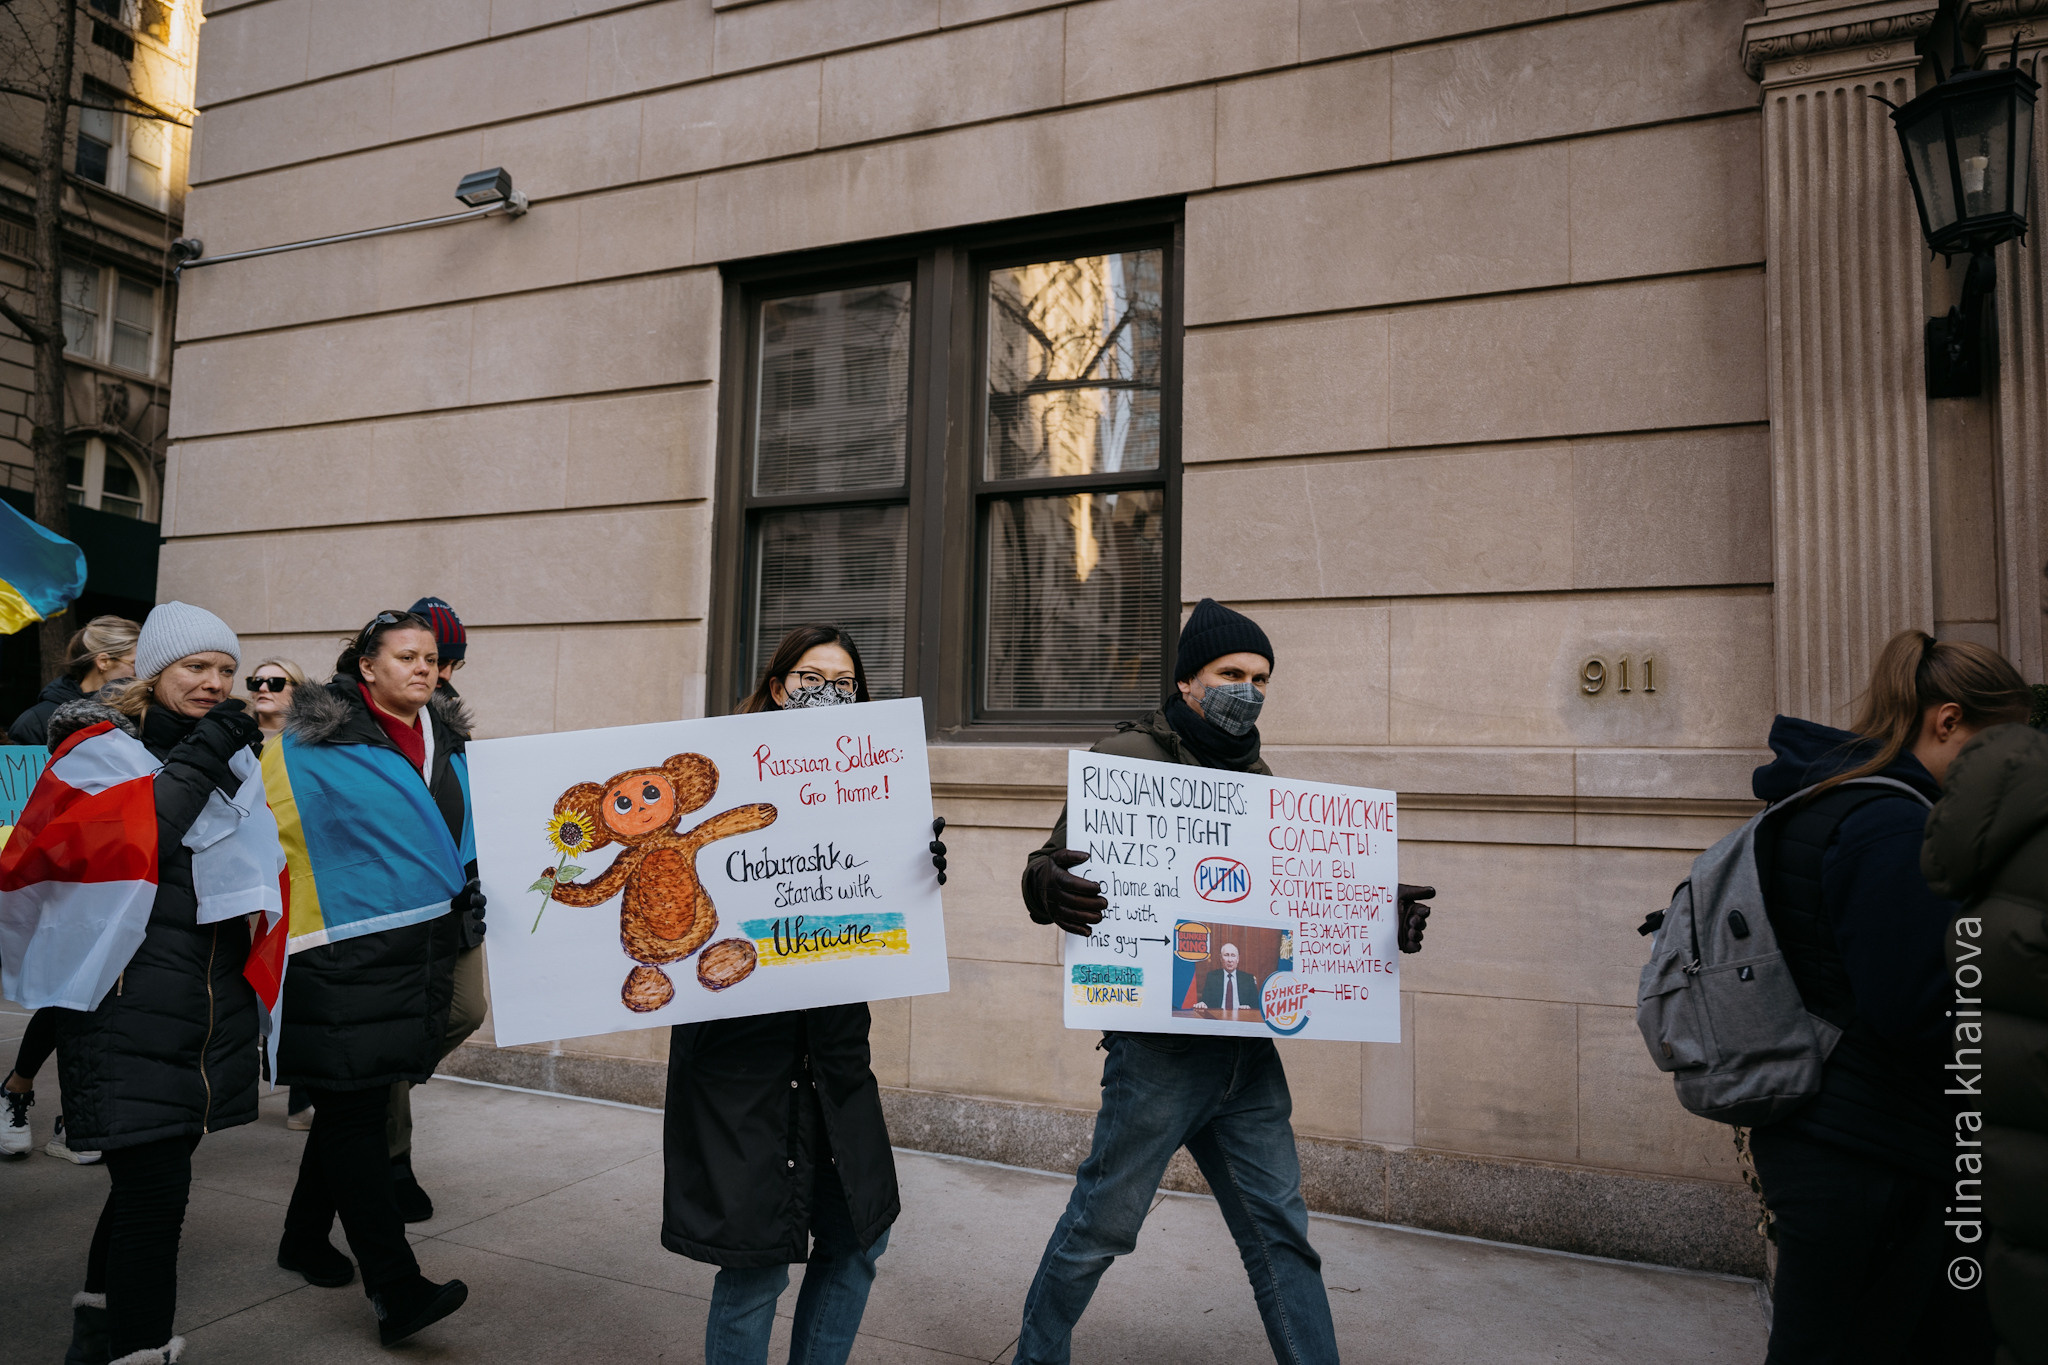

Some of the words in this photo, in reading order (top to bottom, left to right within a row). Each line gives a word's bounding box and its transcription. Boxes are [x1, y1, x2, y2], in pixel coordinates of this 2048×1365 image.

[1583, 657, 1656, 693] 911
[753, 744, 831, 782] Russian
[836, 734, 904, 773] Soldiers:
[800, 782, 827, 806] Go
[835, 775, 890, 805] home!
[1083, 766, 1165, 808] RUSSIAN
[1170, 777, 1247, 816] SOLDIERS:
[1270, 788, 1394, 832] РОССИЙСКИЕ
[1084, 808, 1137, 837] WANT
[1147, 814, 1168, 840] TO
[1177, 816, 1231, 847] FIGHT
[726, 841, 869, 883] Cheburashka
[1272, 856, 1323, 878] ЕСЛИ
[1332, 859, 1355, 879] ВЫ
[774, 875, 833, 908] Stands
[838, 874, 882, 900] with
[1112, 871, 1150, 897] home
[1153, 876, 1181, 898] and
[1200, 865, 1246, 892] PUTIN
[1269, 879, 1333, 901] ХОТИТЕ
[1337, 882, 1394, 904] ВОЕВАТЬ
[1126, 905, 1158, 923] with
[1270, 900, 1280, 916] С
[771, 915, 886, 957] Ukraine
[1178, 931, 1207, 941] BUNKER
[1300, 921, 1369, 940] ЕЗЖАЙТЕ
[1114, 935, 1138, 958] guy
[1178, 941, 1207, 953] KING
[1299, 940, 1351, 957] ДОМОЙ
[1362, 942, 1372, 956] И
[1080, 966, 1110, 984] Stand
[1086, 987, 1140, 1003] UKRAINE
[1264, 983, 1309, 1003] БУНКЕР
[1334, 984, 1369, 1001] НЕГО
[1265, 995, 1309, 1020] КИНГ
